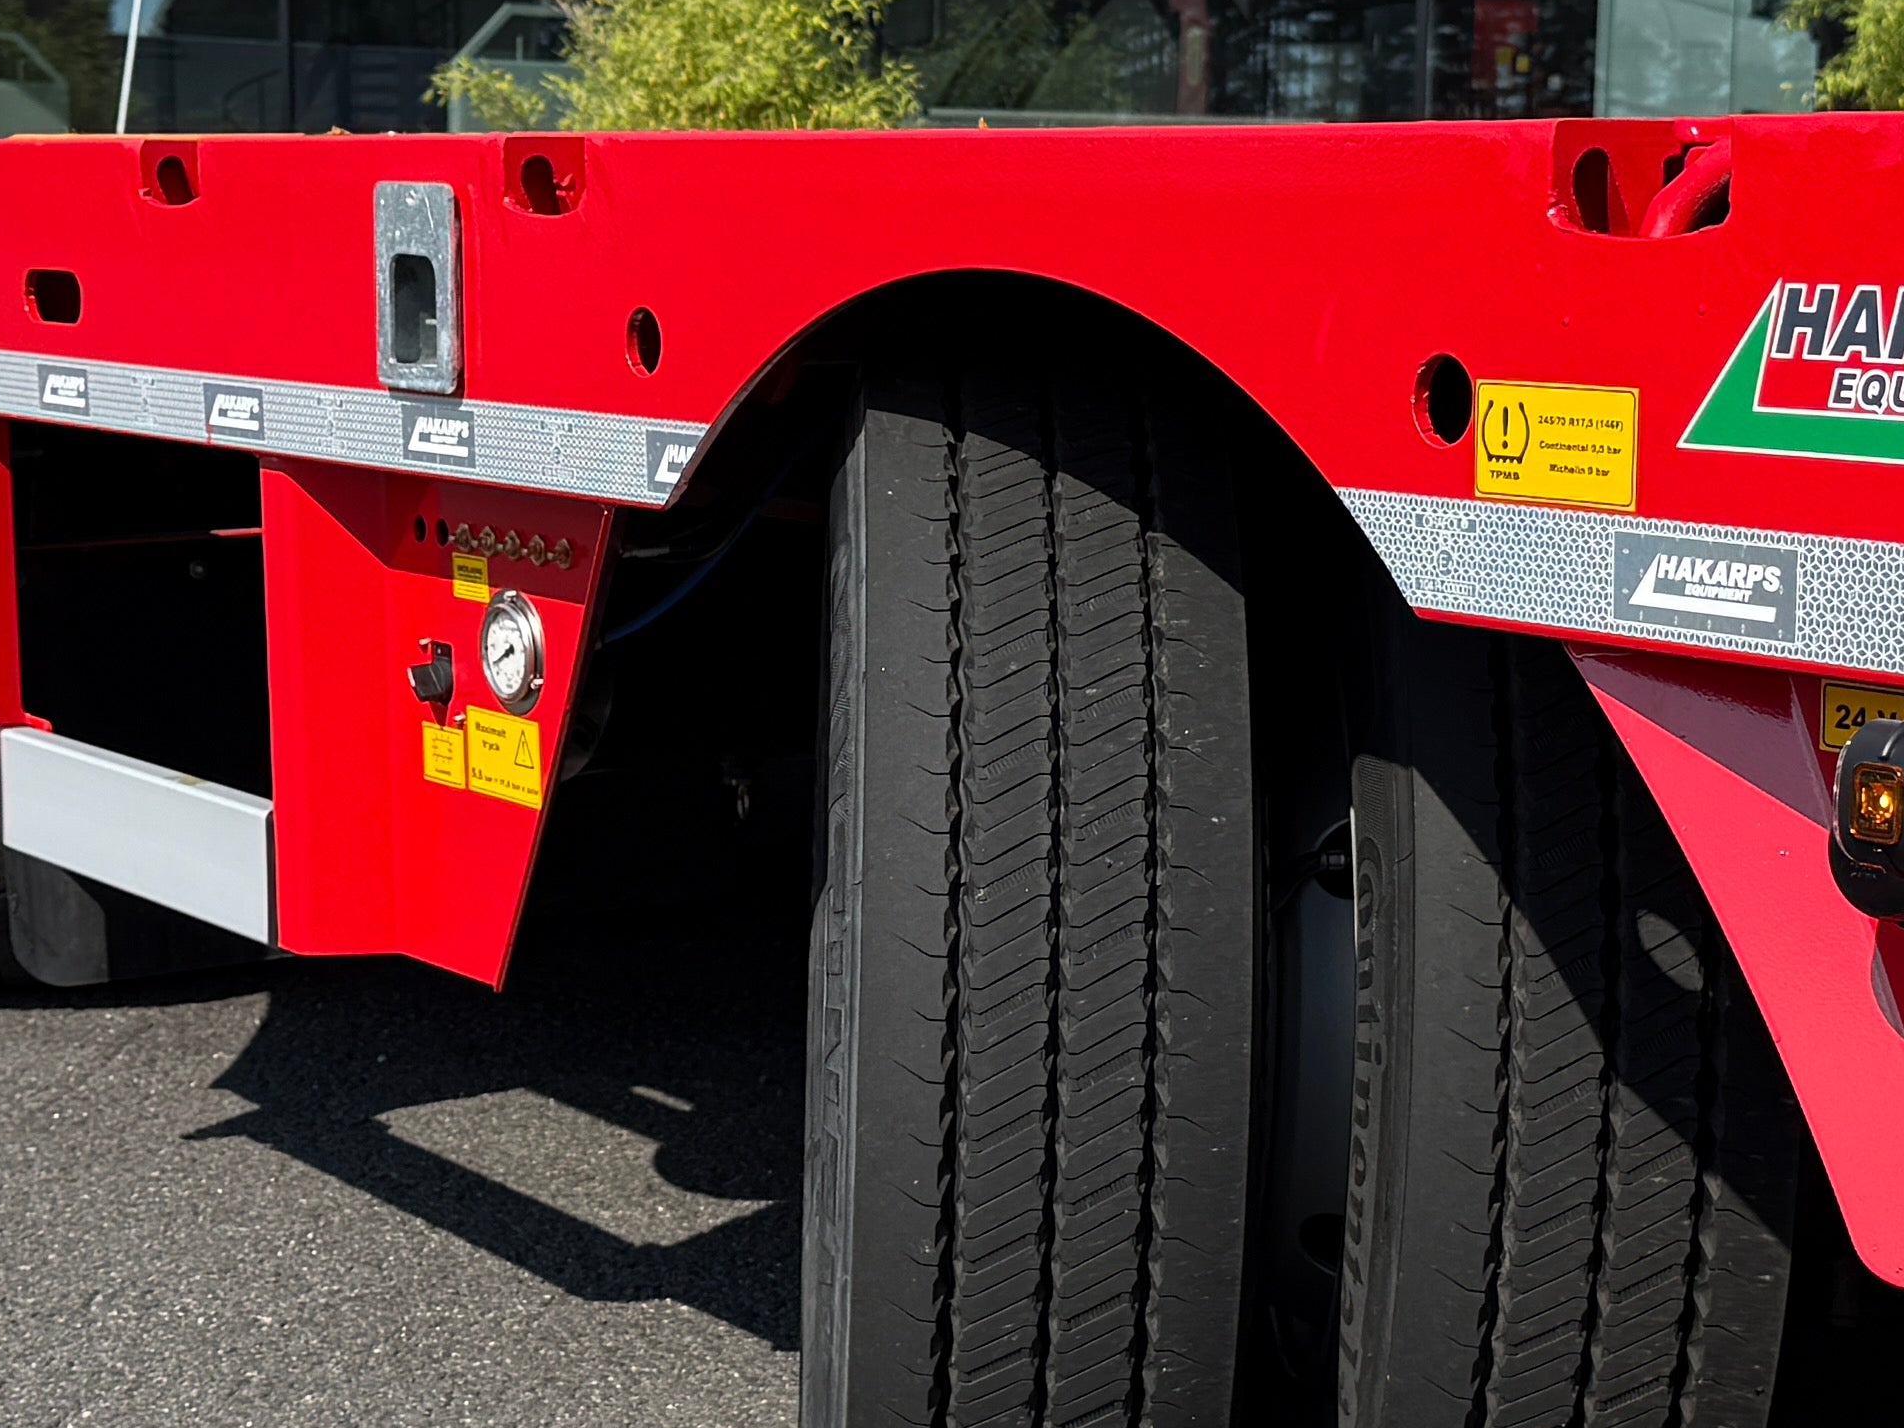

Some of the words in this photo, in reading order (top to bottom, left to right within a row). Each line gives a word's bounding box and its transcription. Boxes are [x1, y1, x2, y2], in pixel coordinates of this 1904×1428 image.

[1657, 553, 1782, 593] HAKARPS
[1684, 583, 1753, 603] EQUIPMENT
[1835, 704, 1866, 730] 24
